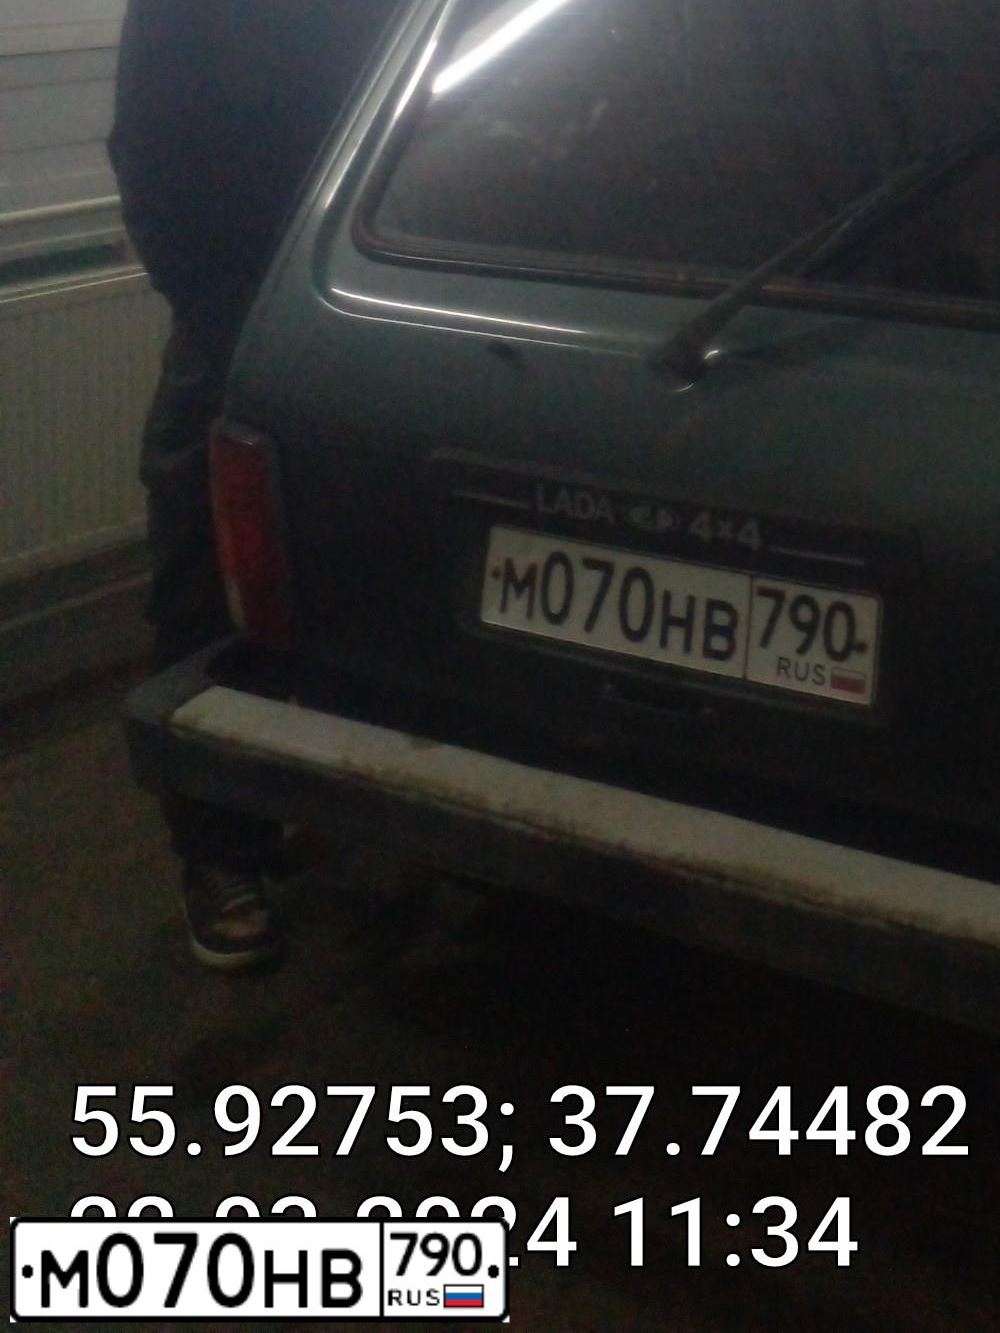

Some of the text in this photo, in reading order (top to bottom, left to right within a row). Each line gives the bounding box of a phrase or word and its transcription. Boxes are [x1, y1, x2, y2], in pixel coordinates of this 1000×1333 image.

[536, 483, 614, 525] LADA
[757, 587, 856, 663] 790
[776, 656, 827, 687] RUS
